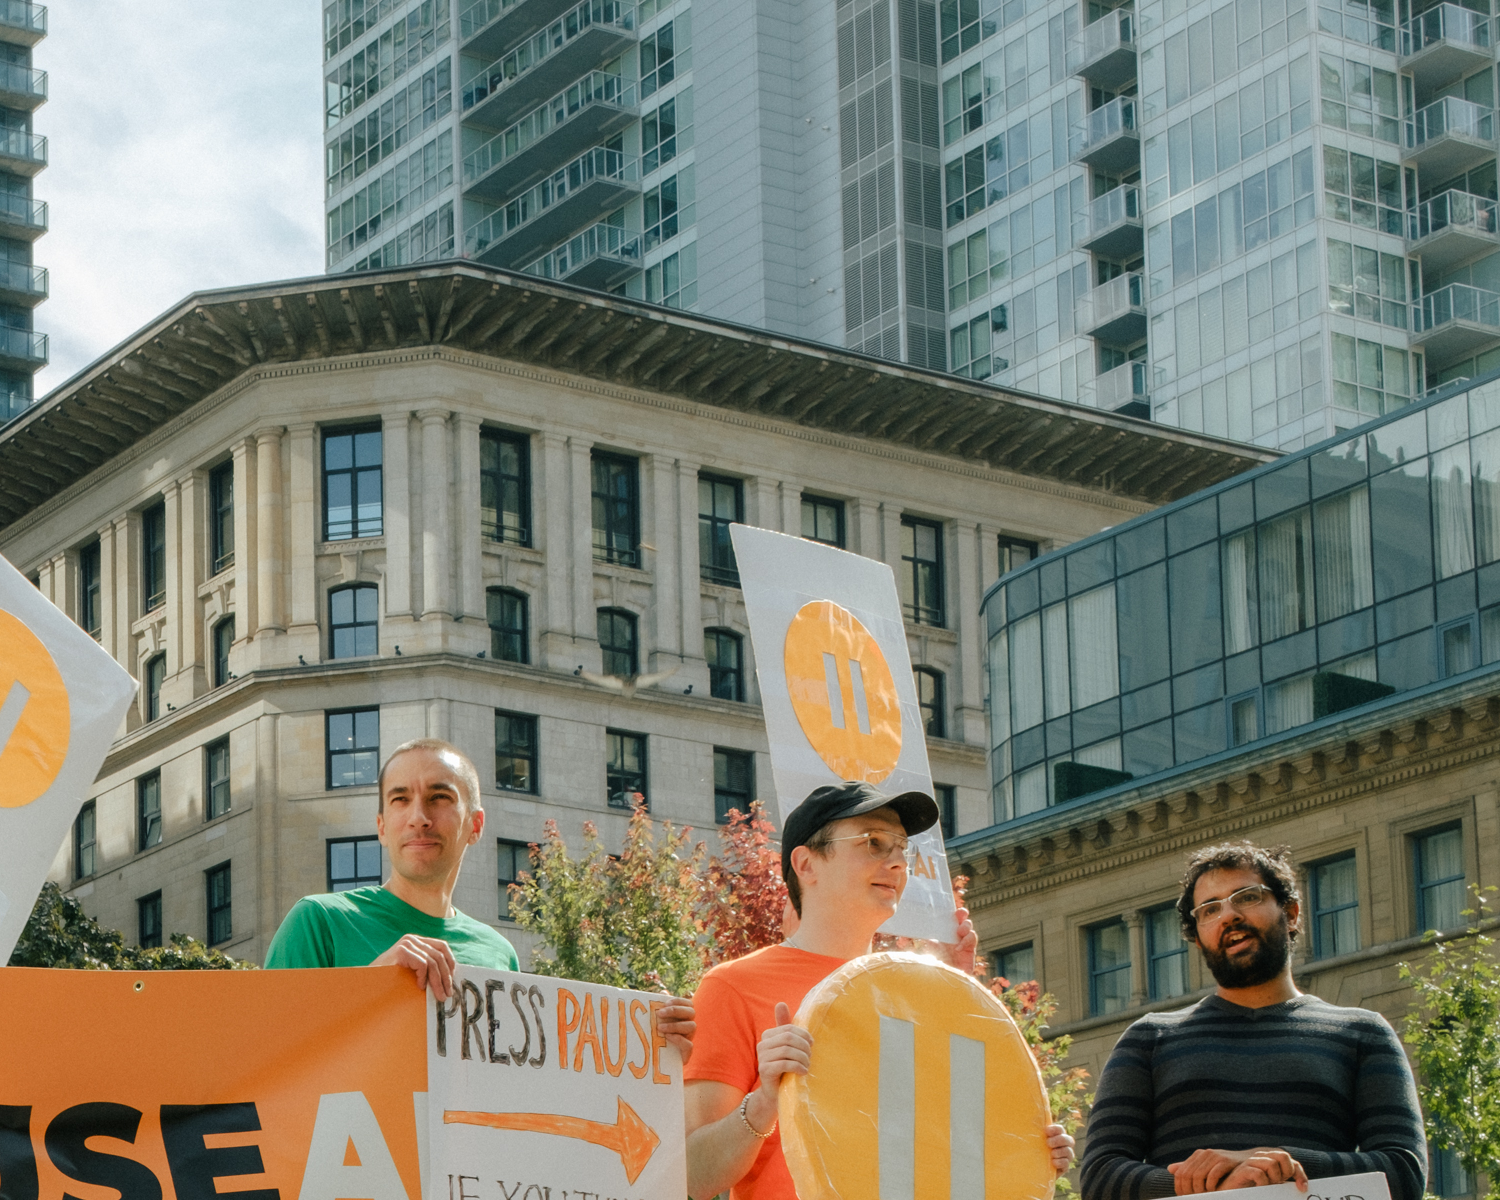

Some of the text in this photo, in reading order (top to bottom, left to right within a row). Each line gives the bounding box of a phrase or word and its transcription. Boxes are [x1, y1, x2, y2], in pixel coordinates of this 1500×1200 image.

[908, 852, 937, 880] AI
[436, 978, 671, 1085] PRESS PAUSE
